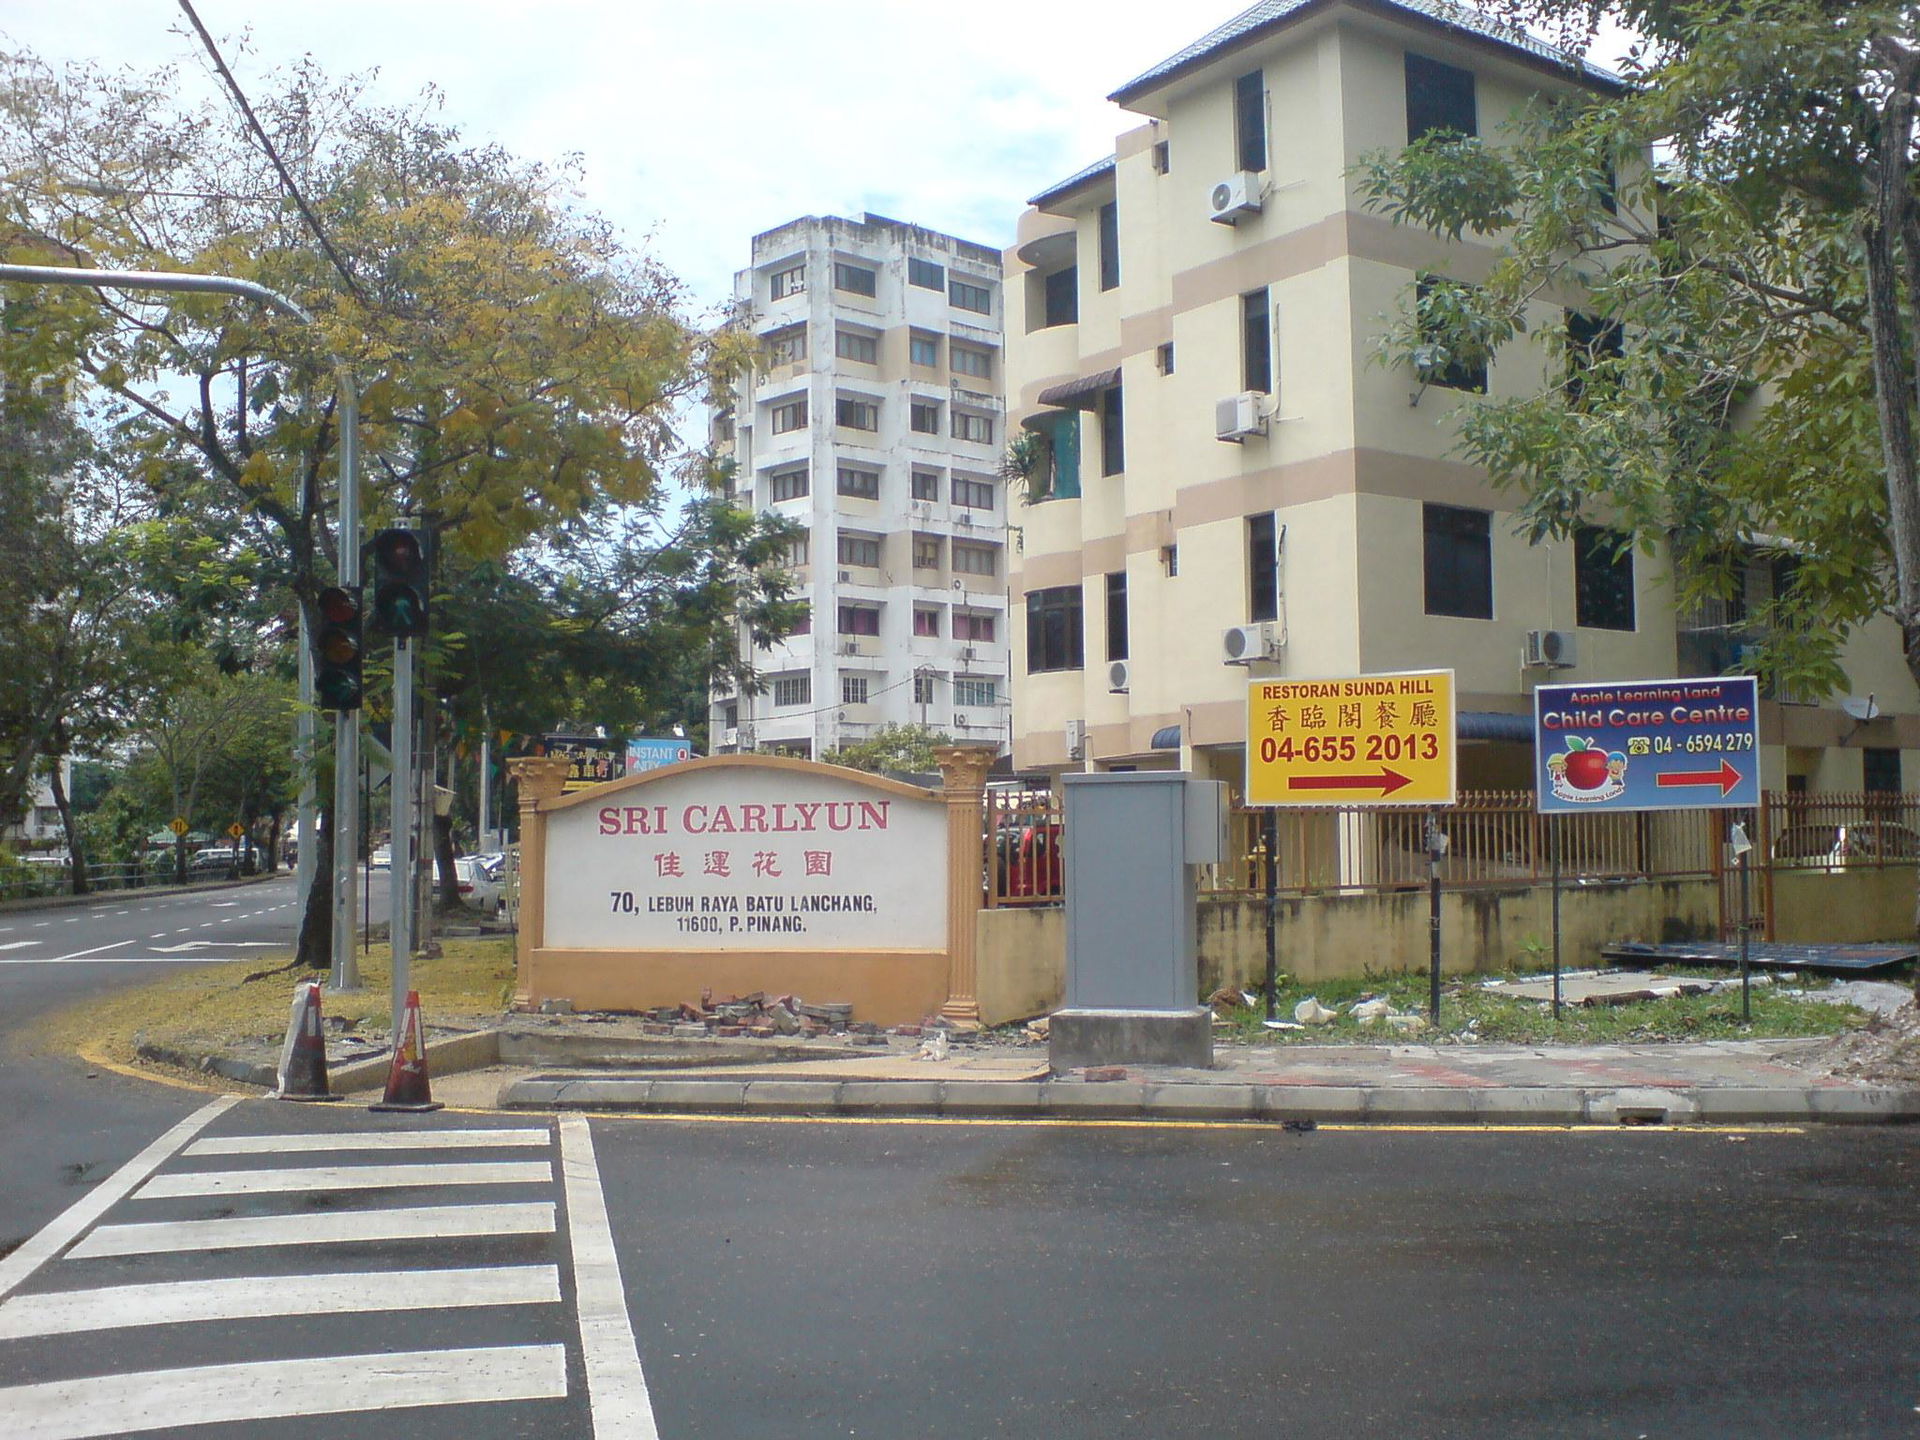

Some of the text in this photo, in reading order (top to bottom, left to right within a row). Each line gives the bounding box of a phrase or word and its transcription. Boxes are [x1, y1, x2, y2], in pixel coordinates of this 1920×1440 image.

[1263, 680, 1433, 699] RESTORAN SUNDA HILL
[1570, 686, 1721, 704] Apple Learning Land
[1267, 700, 1438, 732] 香臨閣餐廳
[1543, 705, 1750, 730] Child Care Centre
[629, 747, 673, 760] INSTANT
[1260, 733, 1438, 763] 04-655 2013
[1654, 736, 1672, 754] 04
[1686, 734, 1723, 752] 6594
[1726, 732, 1753, 750] 279
[599, 801, 891, 835] SRI CARLYUN
[654, 850, 832, 878] 佳運花園
[610, 891, 878, 916] 70, LEBUH RAYA BATU LANCHANG,
[677, 917, 723, 935] 11600,
